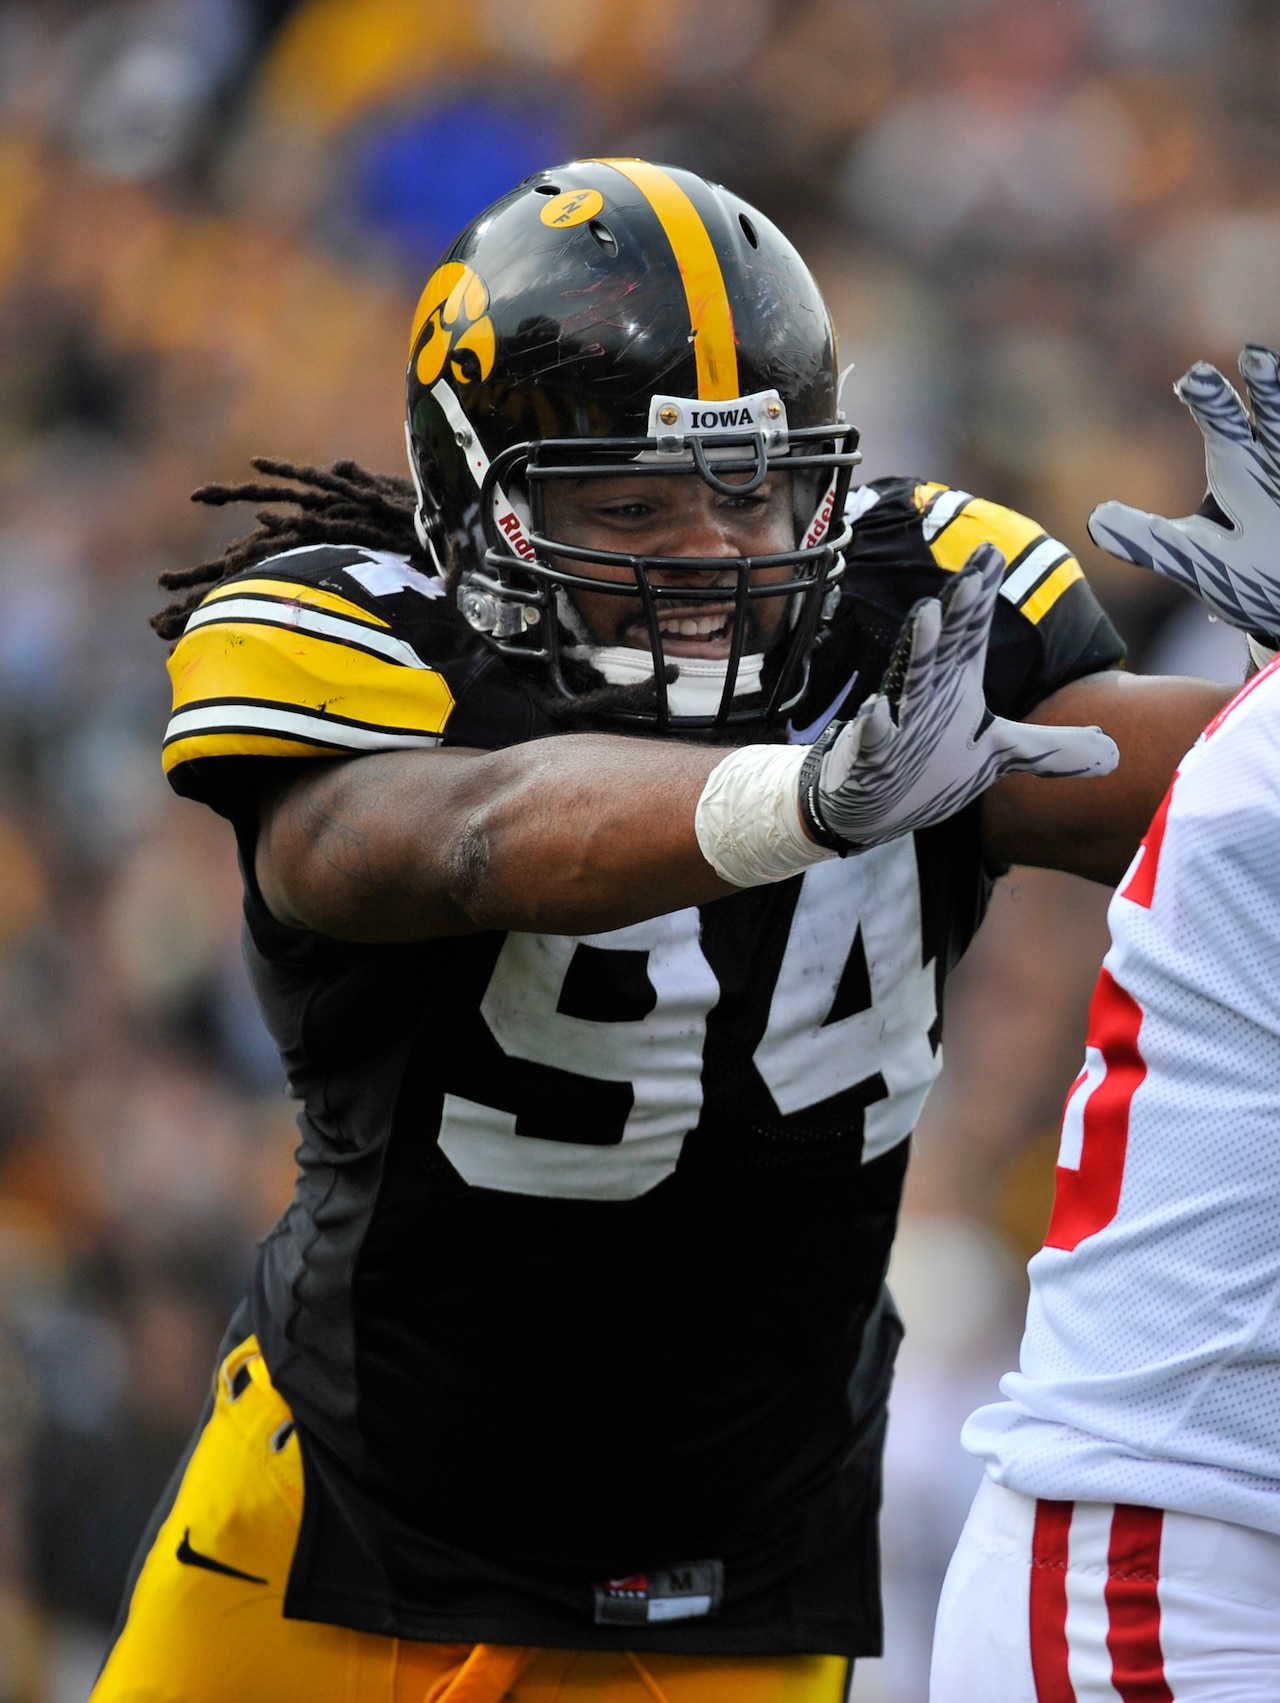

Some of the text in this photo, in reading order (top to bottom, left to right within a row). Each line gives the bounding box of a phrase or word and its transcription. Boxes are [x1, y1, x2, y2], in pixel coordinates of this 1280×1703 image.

[691, 407, 754, 429] IOWA
[437, 831, 943, 1201] 94
[669, 1570, 692, 1592] M
